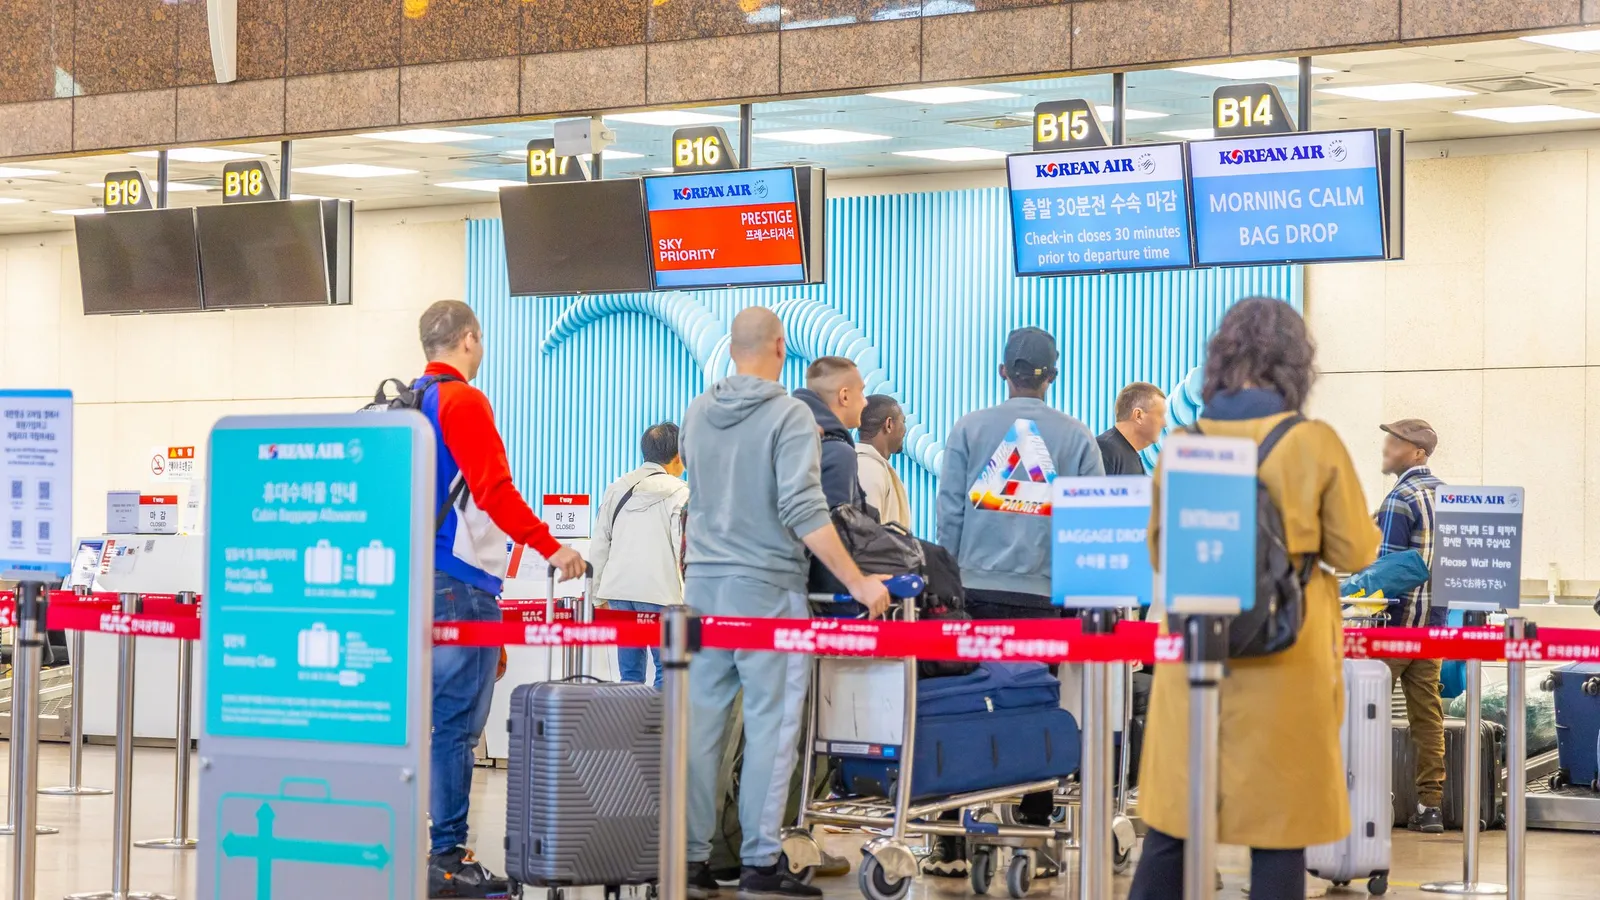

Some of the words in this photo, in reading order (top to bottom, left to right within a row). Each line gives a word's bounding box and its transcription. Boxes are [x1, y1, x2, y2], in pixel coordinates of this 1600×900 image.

[1218, 94, 1272, 128] B14
[1037, 110, 1089, 143] B15
[676, 136, 720, 167] B16
[1219, 147, 1288, 165] KOREAN
[1290, 144, 1325, 161] AIR
[530, 148, 569, 176] B17
[1036, 161, 1100, 178] KOREAN
[1103, 158, 1135, 173] AIR
[225, 169, 262, 196] B18
[673, 185, 724, 200] KOREAN
[727, 184, 752, 197] AIR
[105, 179, 141, 206] B19
[1210, 189, 1302, 213] MORNING
[1309, 186, 1364, 208] CALM
[1022, 197, 1051, 220] 출발
[1057, 195, 1106, 216] 30분전
[1111, 193, 1142, 215] 수속
[1146, 189, 1177, 213] 마감
[741, 210, 793, 225] PRESTIGE
[746, 227, 794, 242] 프레스티지석
[1025, 229, 1074, 246] Check-in
[1078, 228, 1111, 243] closes
[1115, 227, 1129, 241] 30
[1133, 225, 1181, 240] minutes
[1240, 225, 1279, 246] BAG
[1286, 222, 1339, 244] DROP
[659, 238, 683, 250] SKY
[660, 249, 716, 262] PRIORITY
[1038, 250, 1064, 266] prior
[1067, 251, 1080, 263] to
[1083, 248, 1140, 264] departure
[1143, 246, 1170, 259] time
[258, 444, 315, 460] KOREAN
[316, 443, 345, 459] AIR
[1063, 488, 1105, 497] KOREAN
[1109, 488, 1128, 496] AIR
[1440, 494, 1482, 505] KOREAN
[1484, 495, 1505, 505] AIR
[999, 498, 1042, 514] PALACE
[1058, 529, 1114, 543] BAGGAGE
[1440, 556, 1467, 567] Please
[1471, 558, 1488, 568] Wait
[1492, 558, 1511, 569] Here
[1445, 578, 1506, 590] こちらでお待ち下さい
[1505, 641, 1542, 659] KAC
